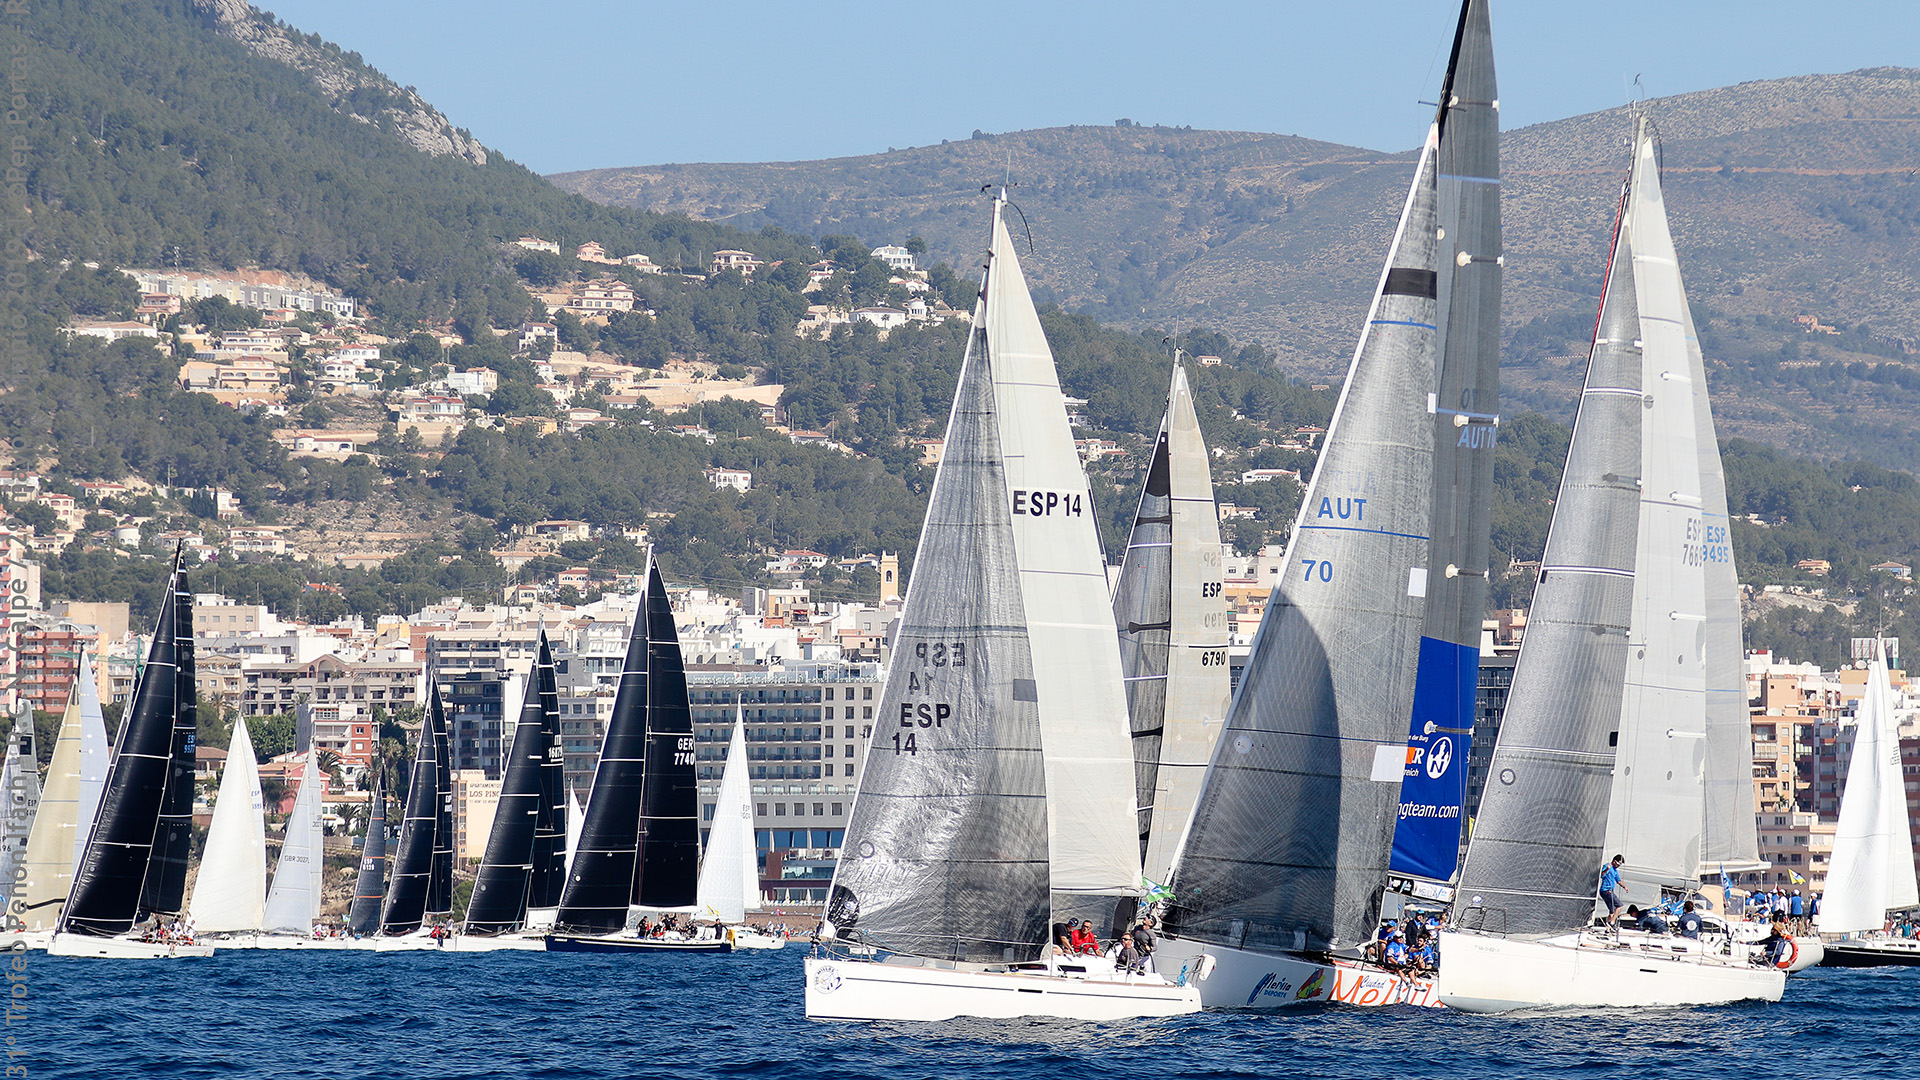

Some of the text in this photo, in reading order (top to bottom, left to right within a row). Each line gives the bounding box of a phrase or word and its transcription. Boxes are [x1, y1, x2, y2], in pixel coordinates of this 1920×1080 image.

[1013, 490, 1082, 517] ESP 14
[1318, 497, 1367, 520] AUT
[1707, 526, 1726, 543] ESP
[1302, 560, 1333, 583] 70
[1203, 582, 1222, 598] ESP
[1202, 651, 1226, 667] 6790
[901, 703, 950, 728] ESP
[678, 738, 694, 751] GER
[892, 732, 917, 756] 14
[674, 753, 696, 765] 7740
[1264, 989, 1288, 998] DEPORTE
